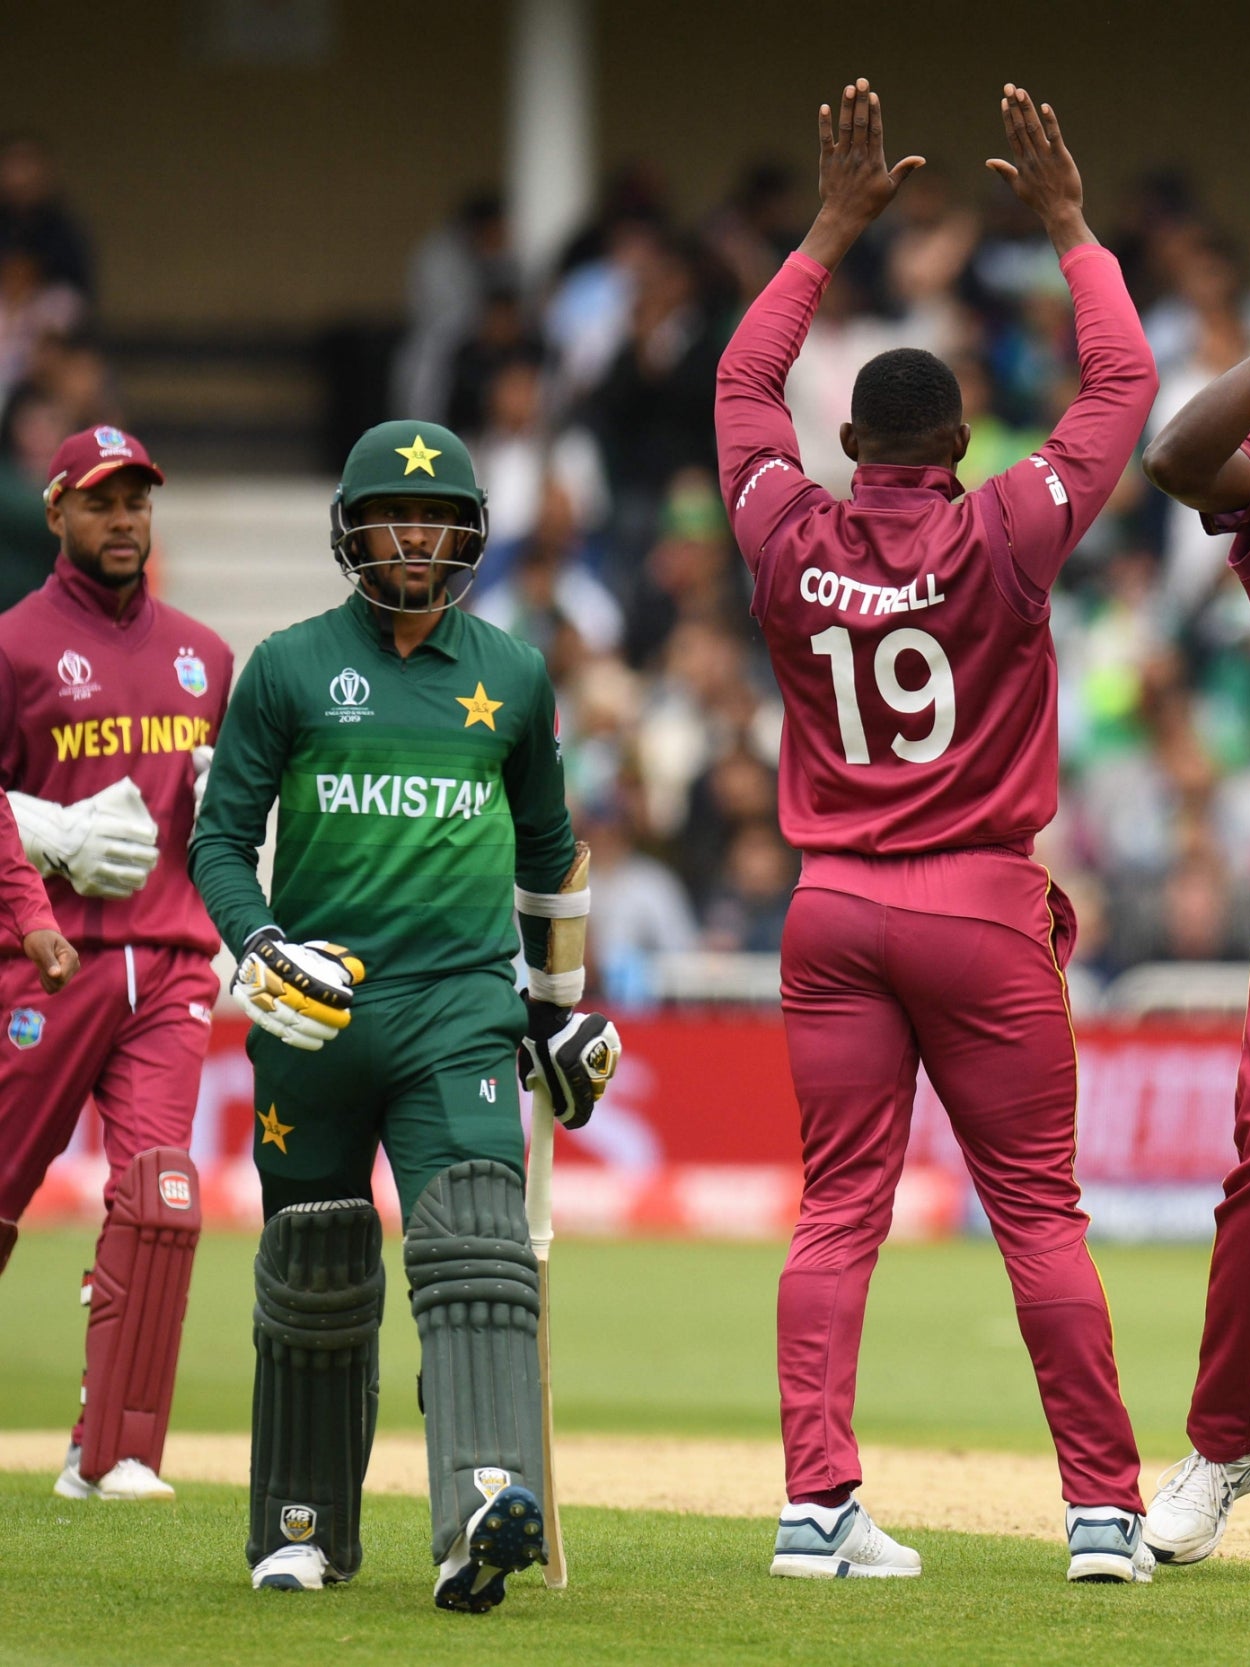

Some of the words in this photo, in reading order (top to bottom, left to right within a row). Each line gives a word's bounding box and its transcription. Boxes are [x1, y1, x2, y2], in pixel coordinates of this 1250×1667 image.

[800, 567, 945, 616] COTTRELL
[810, 625, 956, 764] 19
[51, 716, 132, 762] WEST
[316, 773, 492, 820] PAKISTAN
[164, 1180, 189, 1200] SS
